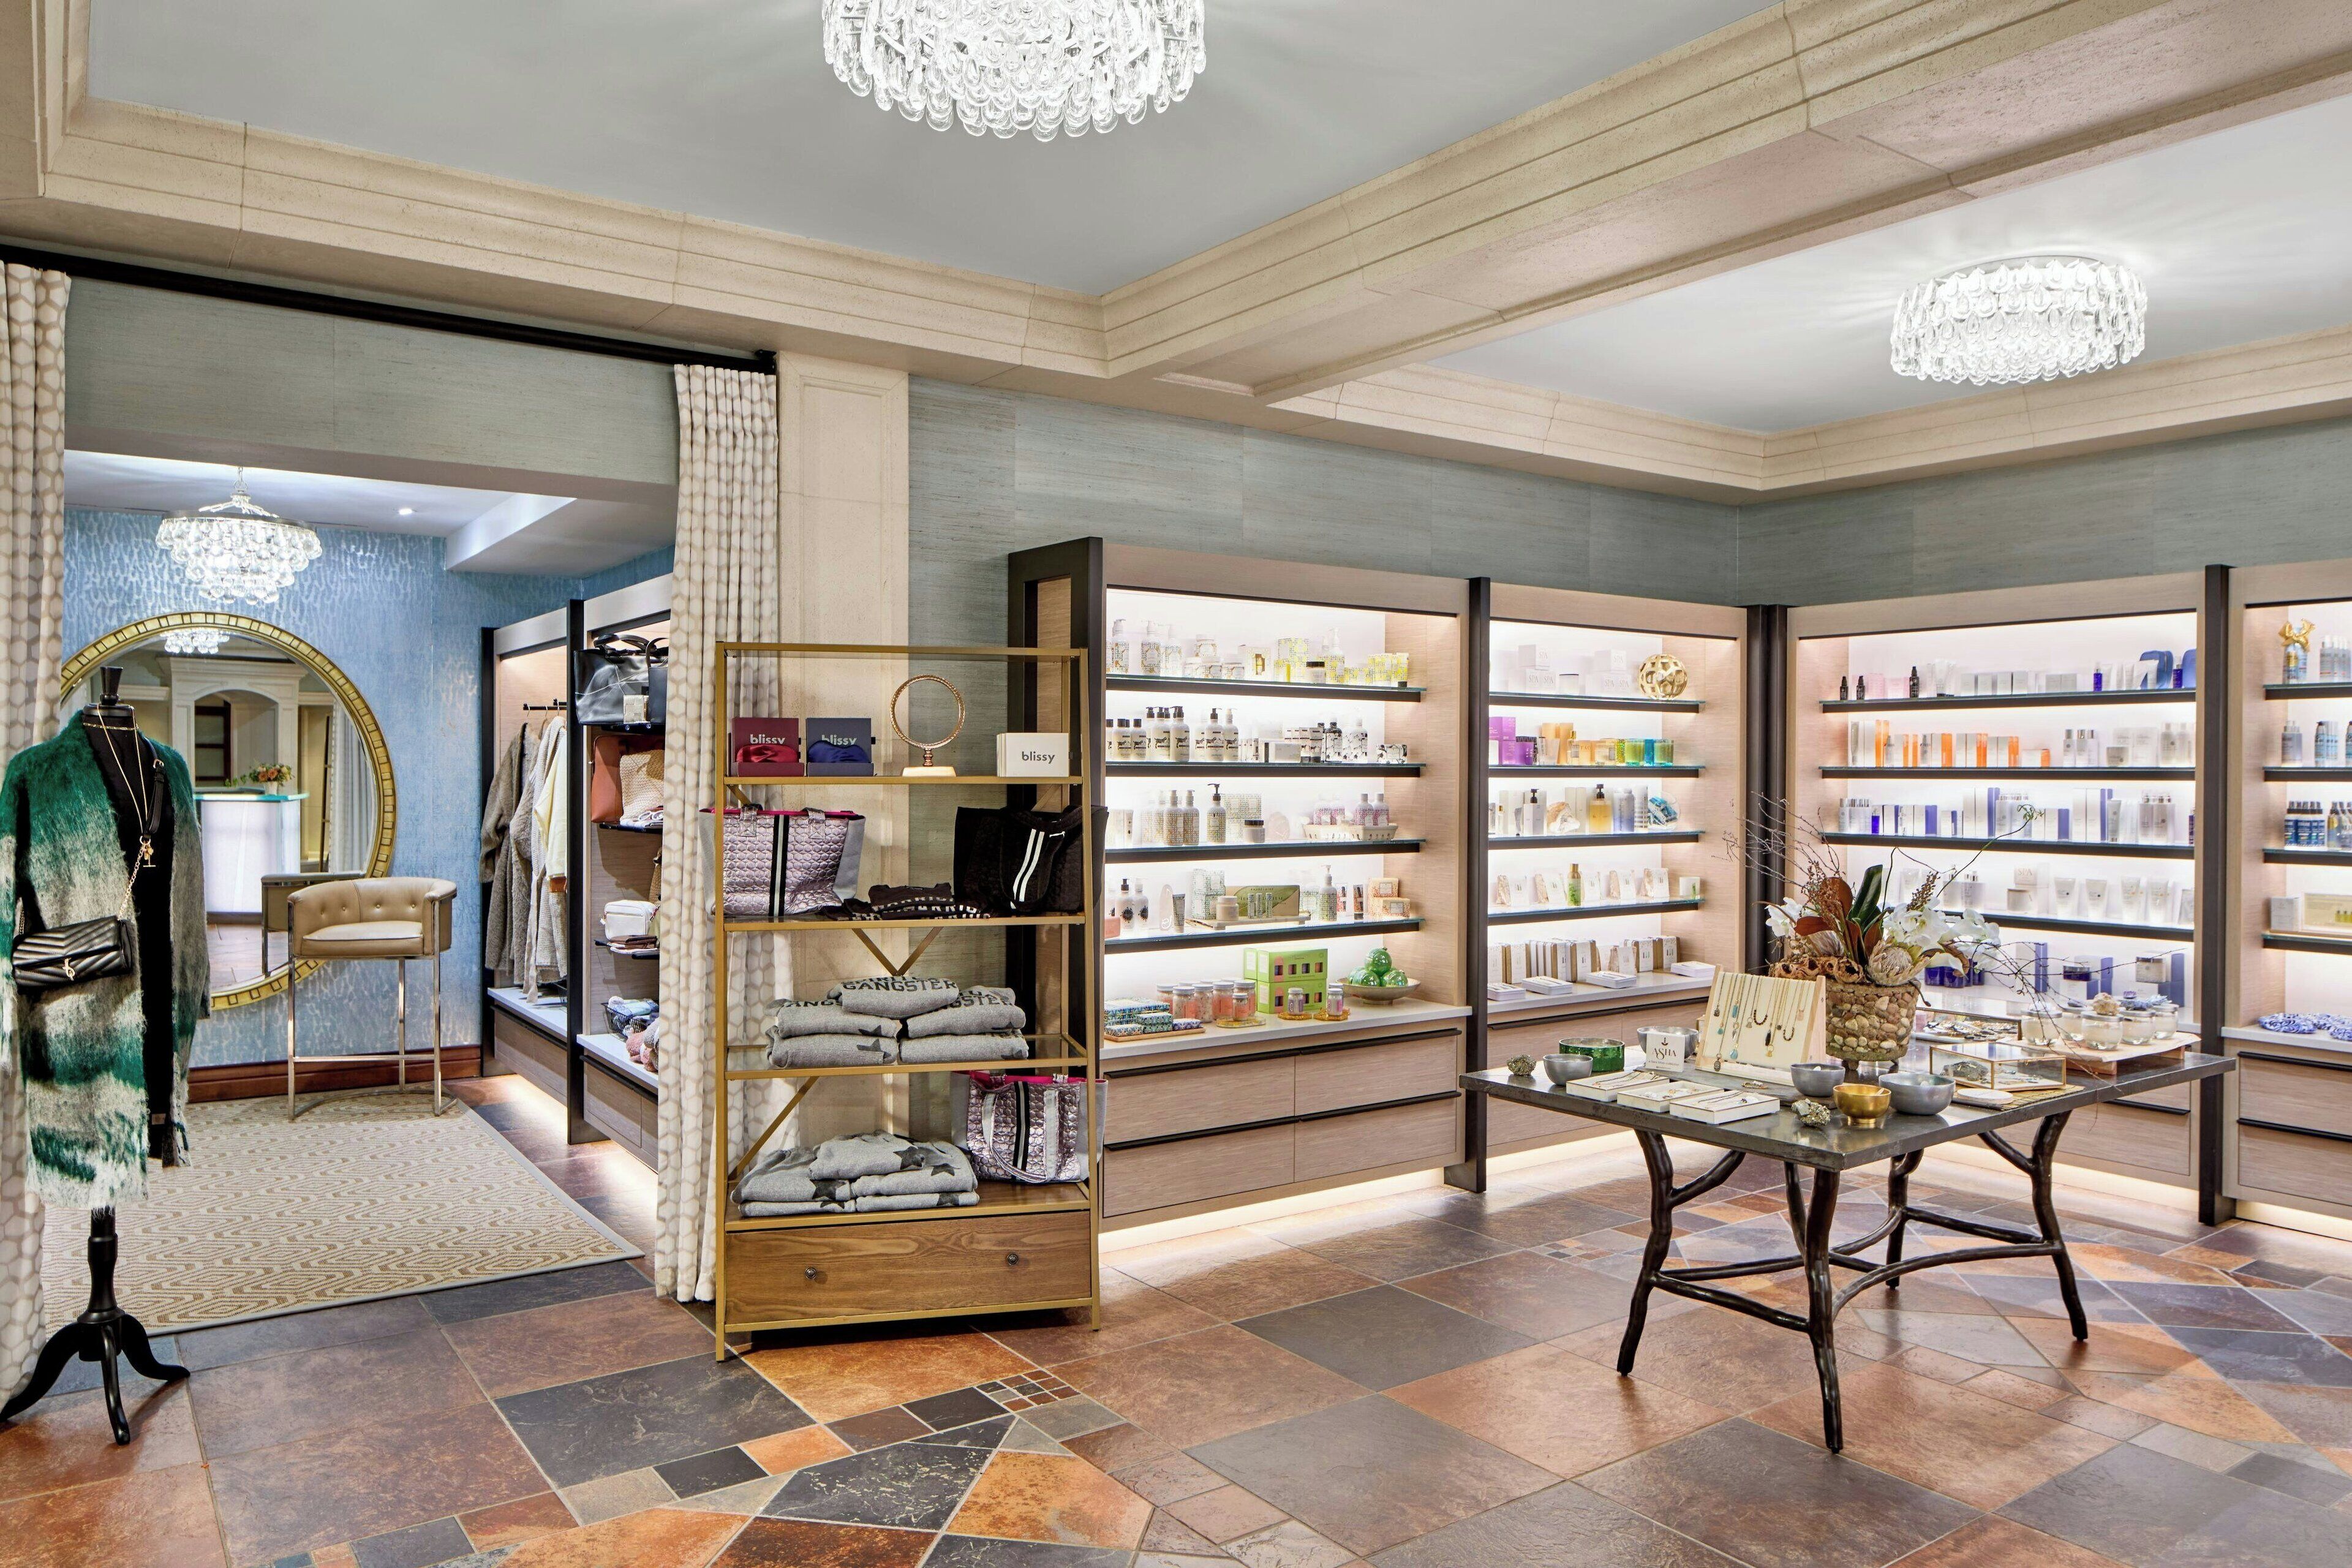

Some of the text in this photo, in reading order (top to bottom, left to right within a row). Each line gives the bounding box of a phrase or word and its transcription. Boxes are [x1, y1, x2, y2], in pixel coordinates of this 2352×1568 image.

[1539, 651, 1548, 660] SPA
[1529, 674, 1539, 683] SPA
[1544, 676, 1554, 684] SPA
[1605, 679, 1615, 687] SPA
[750, 734, 786, 744] blissy
[1022, 751, 1055, 764] blissy
[2018, 868, 2032, 876] SPA
[843, 980, 957, 992] GANGSTER
[1652, 1047, 1676, 1060] ASHA
